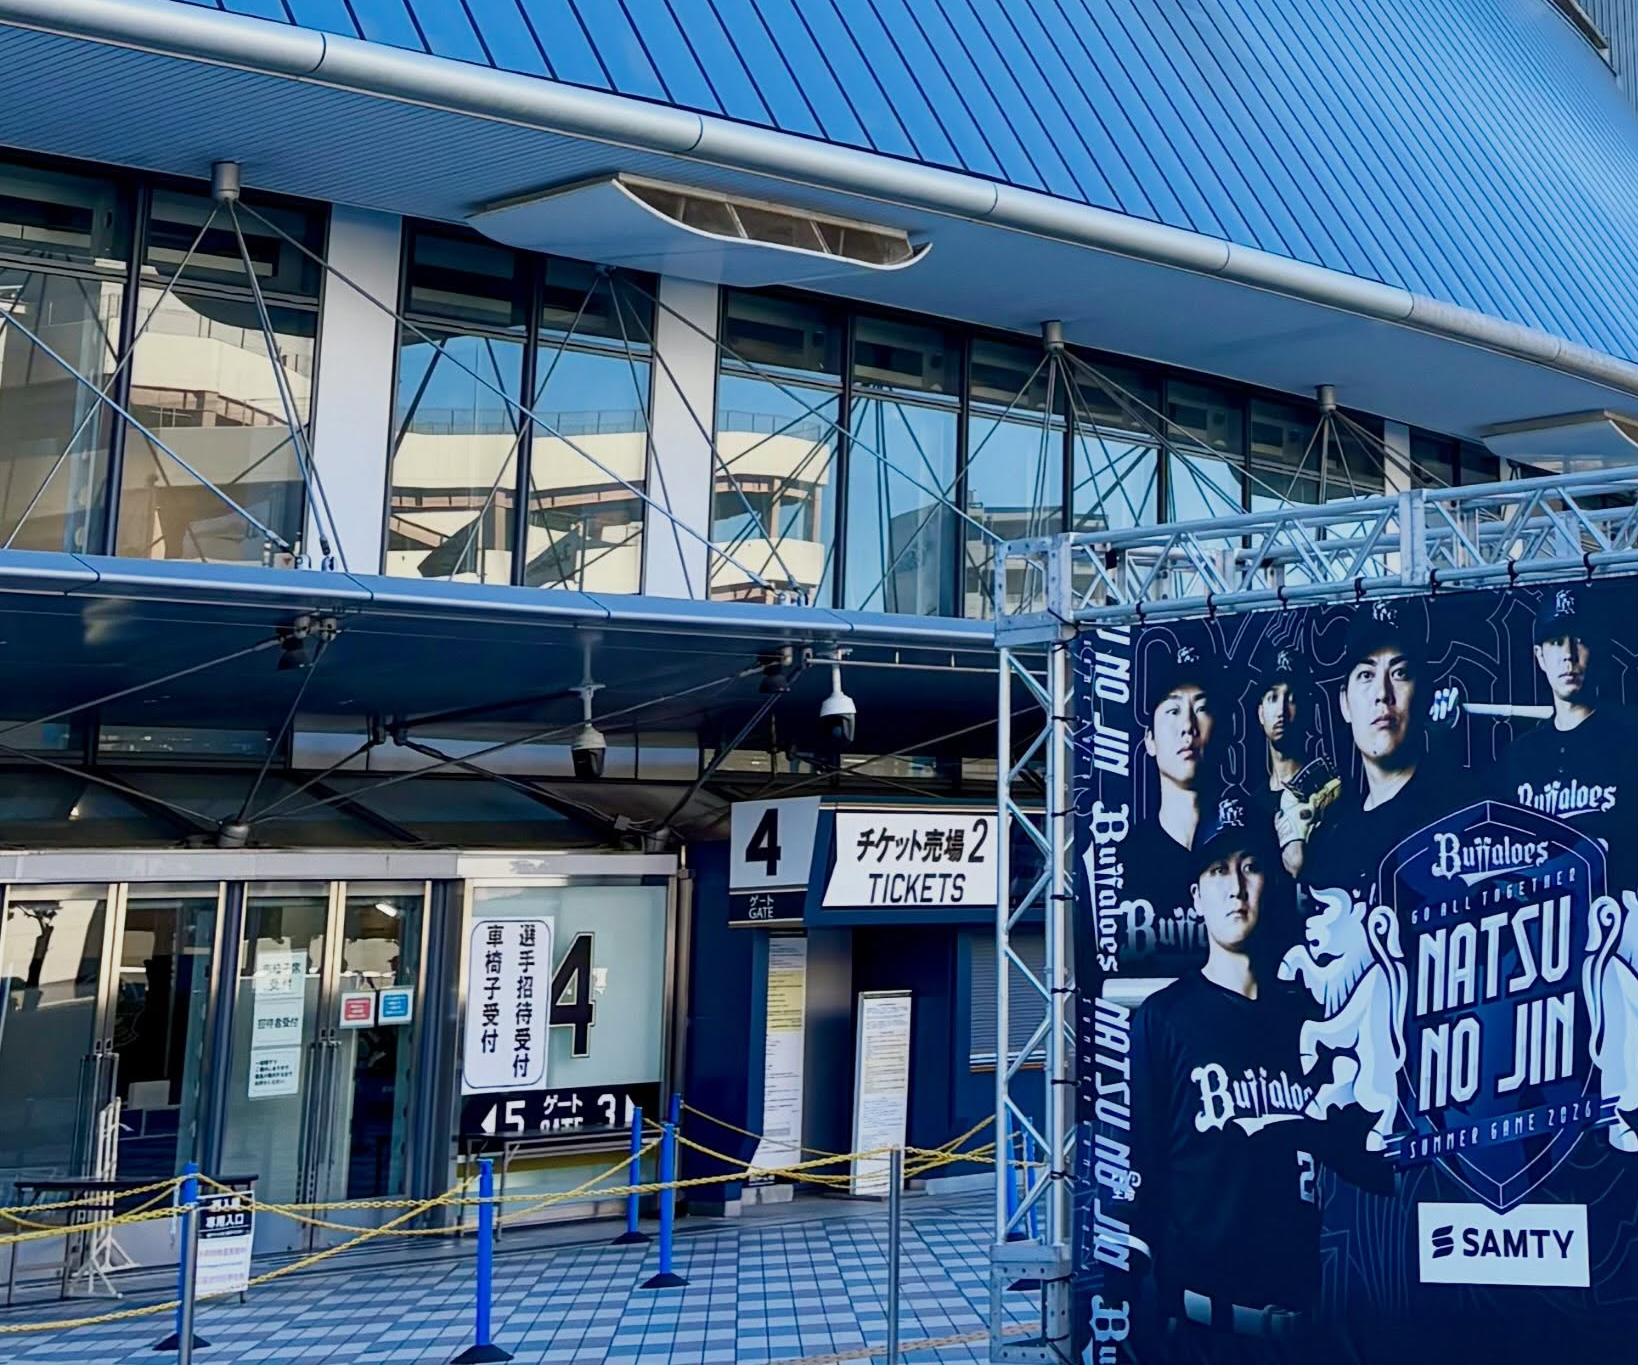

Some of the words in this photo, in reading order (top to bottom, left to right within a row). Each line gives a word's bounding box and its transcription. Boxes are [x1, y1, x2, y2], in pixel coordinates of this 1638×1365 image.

[1094, 652, 1131, 705] NO
[1093, 711, 1130, 777] JIN
[745, 808, 782, 876] 4
[1431, 832, 1549, 881] Buffaloes
[748, 906, 774, 920] GATE
[749, 894, 775, 906] ゲート
[869, 873, 967, 904] TICKETS
[1082, 800, 1130, 973] Buffaloes
[1411, 906, 1430, 925] GO
[1440, 896, 1471, 917] ALL
[1482, 867, 1576, 906] TOGETHER
[1416, 895, 1572, 1016] NATSU
[480, 924, 505, 1054] 車椅子受付
[512, 924, 537, 1079] 選手招待受付
[549, 931, 596, 1058] 4
[1094, 997, 1131, 1131] NATSU
[1418, 1017, 1480, 1112] NO
[1497, 991, 1575, 1093] JIN
[504, 1100, 526, 1132] 5
[542, 1093, 584, 1116] ゲート
[597, 1093, 617, 1125] 3
[1408, 1126, 1479, 1159] SUMMER
[1490, 1113, 1535, 1141] GAME
[1548, 1100, 1593, 1127] 2026
[1462, 1227, 1575, 1259] SAMTY
